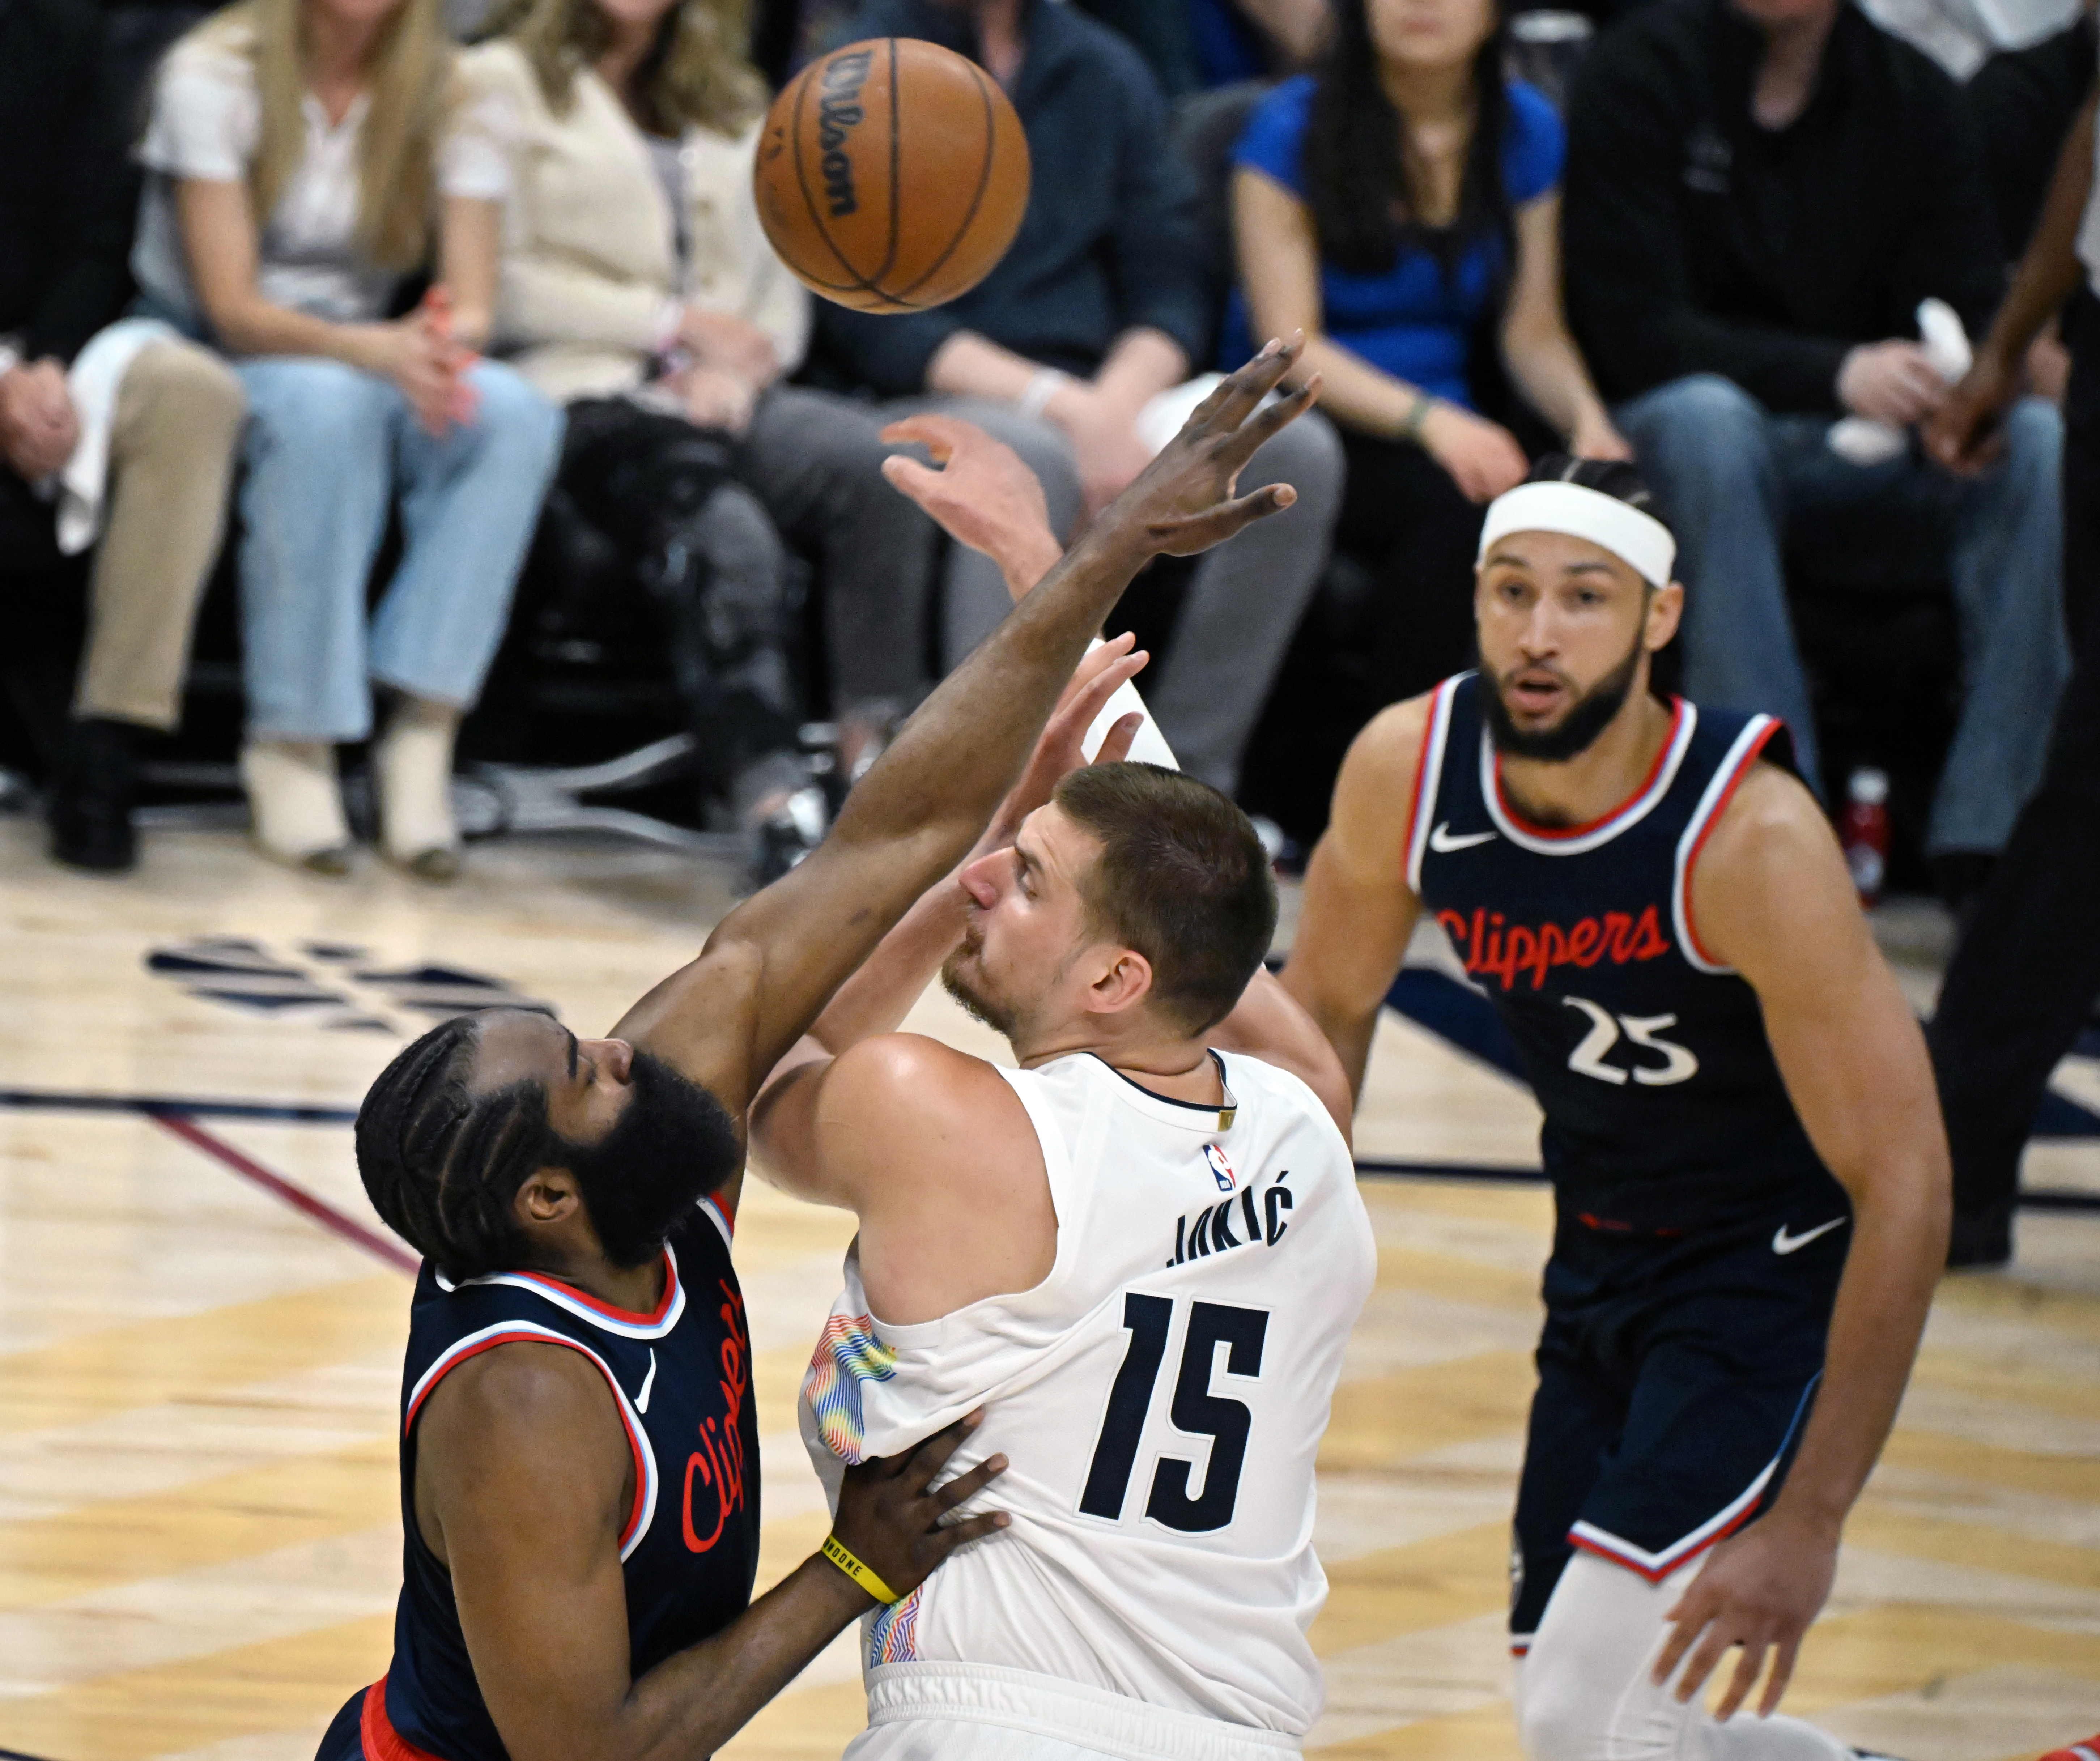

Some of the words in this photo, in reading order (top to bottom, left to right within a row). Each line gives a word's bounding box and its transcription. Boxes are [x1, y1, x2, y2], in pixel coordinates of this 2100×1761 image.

[820, 50, 873, 216] Wilson
[1563, 996, 1698, 1085] 25
[1078, 1290, 1271, 1534] 15
